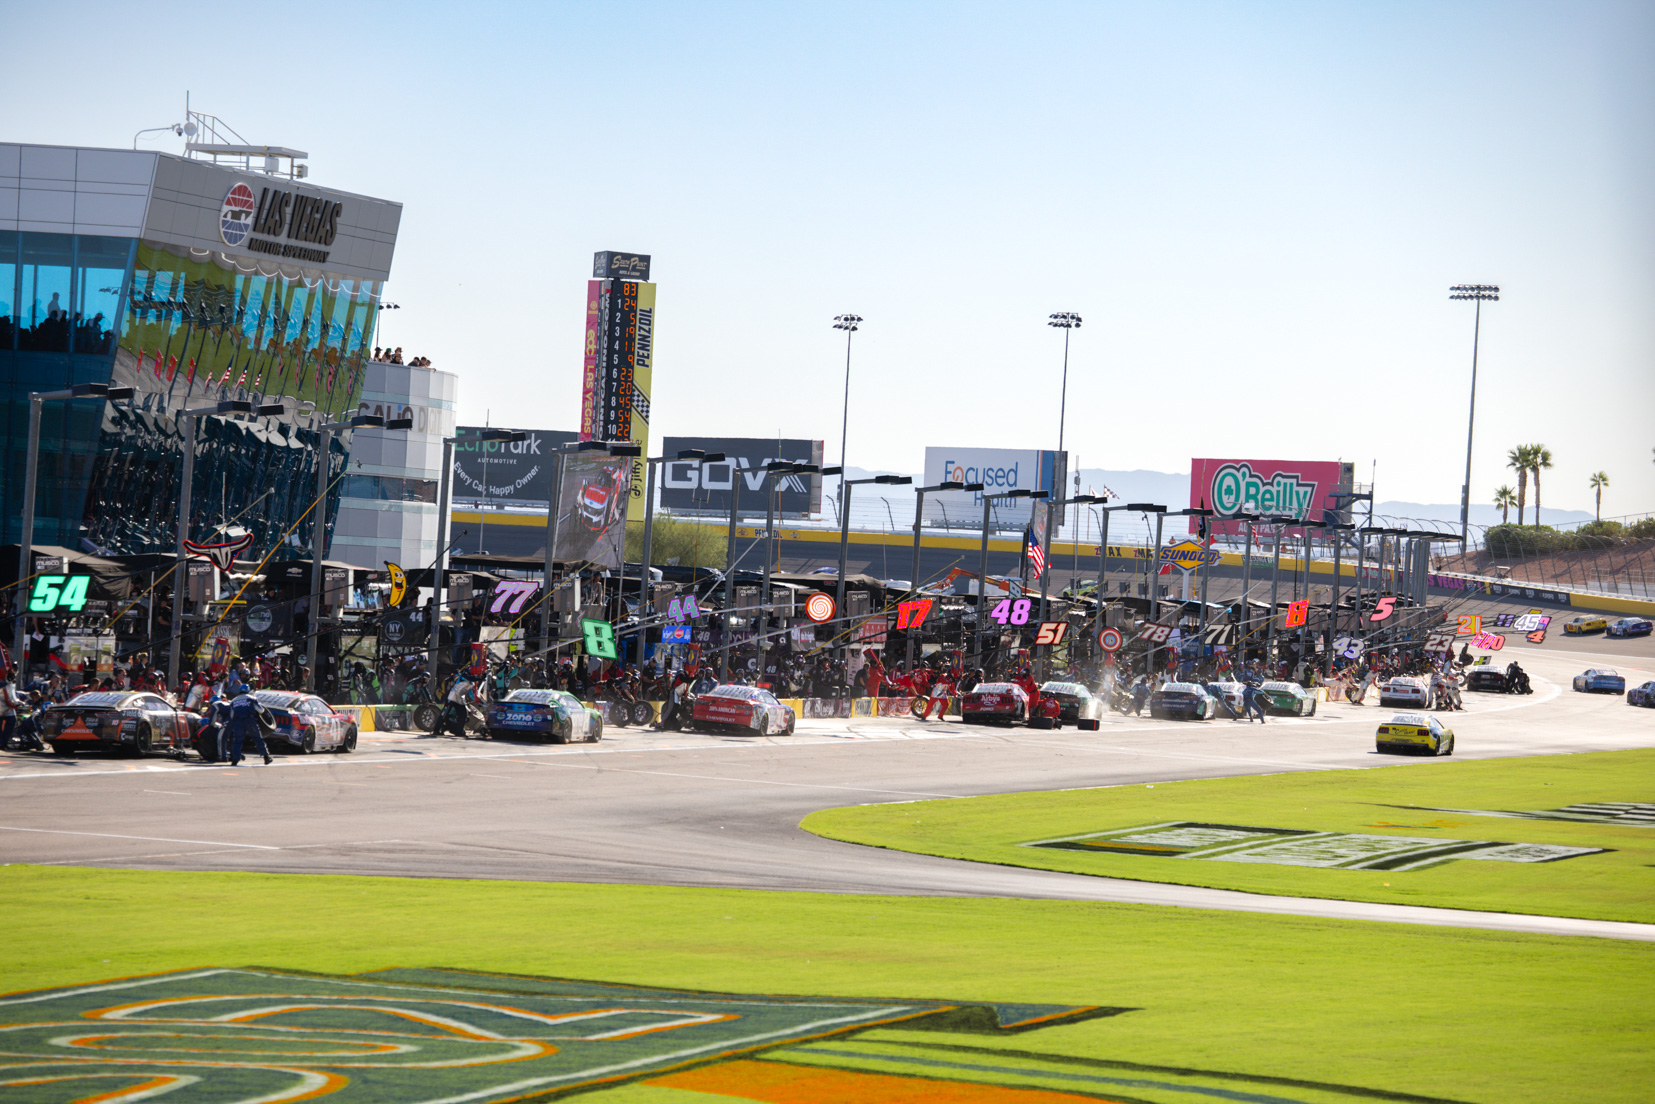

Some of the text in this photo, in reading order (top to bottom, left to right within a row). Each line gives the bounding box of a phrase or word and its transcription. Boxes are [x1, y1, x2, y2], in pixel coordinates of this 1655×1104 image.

[253, 187, 343, 246] LAS VEGAS
[248, 238, 330, 263] MOTOR SPEEDWAY
[624, 283, 636, 296] 83
[617, 298, 636, 310] 1 24
[616, 313, 635, 324] 2 5
[615, 327, 635, 338] 3 19
[636, 307, 652, 368] PENNZOIL
[614, 341, 634, 352] 4 11
[614, 355, 634, 366] 5 9
[584, 329, 596, 434] edc LAS VEGAS
[613, 368, 632, 380] 6 23
[612, 382, 632, 394] 7 20
[611, 396, 630, 408] 8 45
[610, 410, 630, 422] 9 54
[608, 424, 630, 436] 10 22
[454, 461, 472, 485] Every
[490, 485, 514, 496] Happy
[631, 461, 642, 482] jiffy
[664, 457, 809, 493] GOVX
[945, 461, 1018, 487] Focused
[974, 490, 1016, 508] Halth
[1217, 470, 1308, 518] O'Reilly
[754, 529, 783, 539] PENOIL
[1238, 522, 1285, 533] AUO PARS
[1161, 549, 1216, 562] SUNOCO
[1436, 576, 1465, 590] VEGAS
[30, 576, 90, 611] 54
[491, 580, 538, 613] 77
[410, 612, 423, 622] 44
[668, 595, 700, 622] 44
[897, 599, 932, 630] 17
[990, 599, 1031, 625] 48
[1285, 600, 1309, 628] 6
[1370, 597, 1397, 621] 5
[390, 624, 400, 632] NY
[1457, 615, 1481, 634] 21
[1514, 614, 1542, 630] 45
[582, 618, 617, 659] 8
[698, 631, 710, 641] 48
[1034, 622, 1068, 645] 51
[1140, 622, 1172, 643] 78
[1205, 624, 1231, 645] 71
[1527, 630, 1546, 643] 4
[1332, 637, 1364, 659] 43
[1423, 634, 1455, 652] 23
[766, 666, 777, 674] 48
[981, 694, 1000, 703] Arby's
